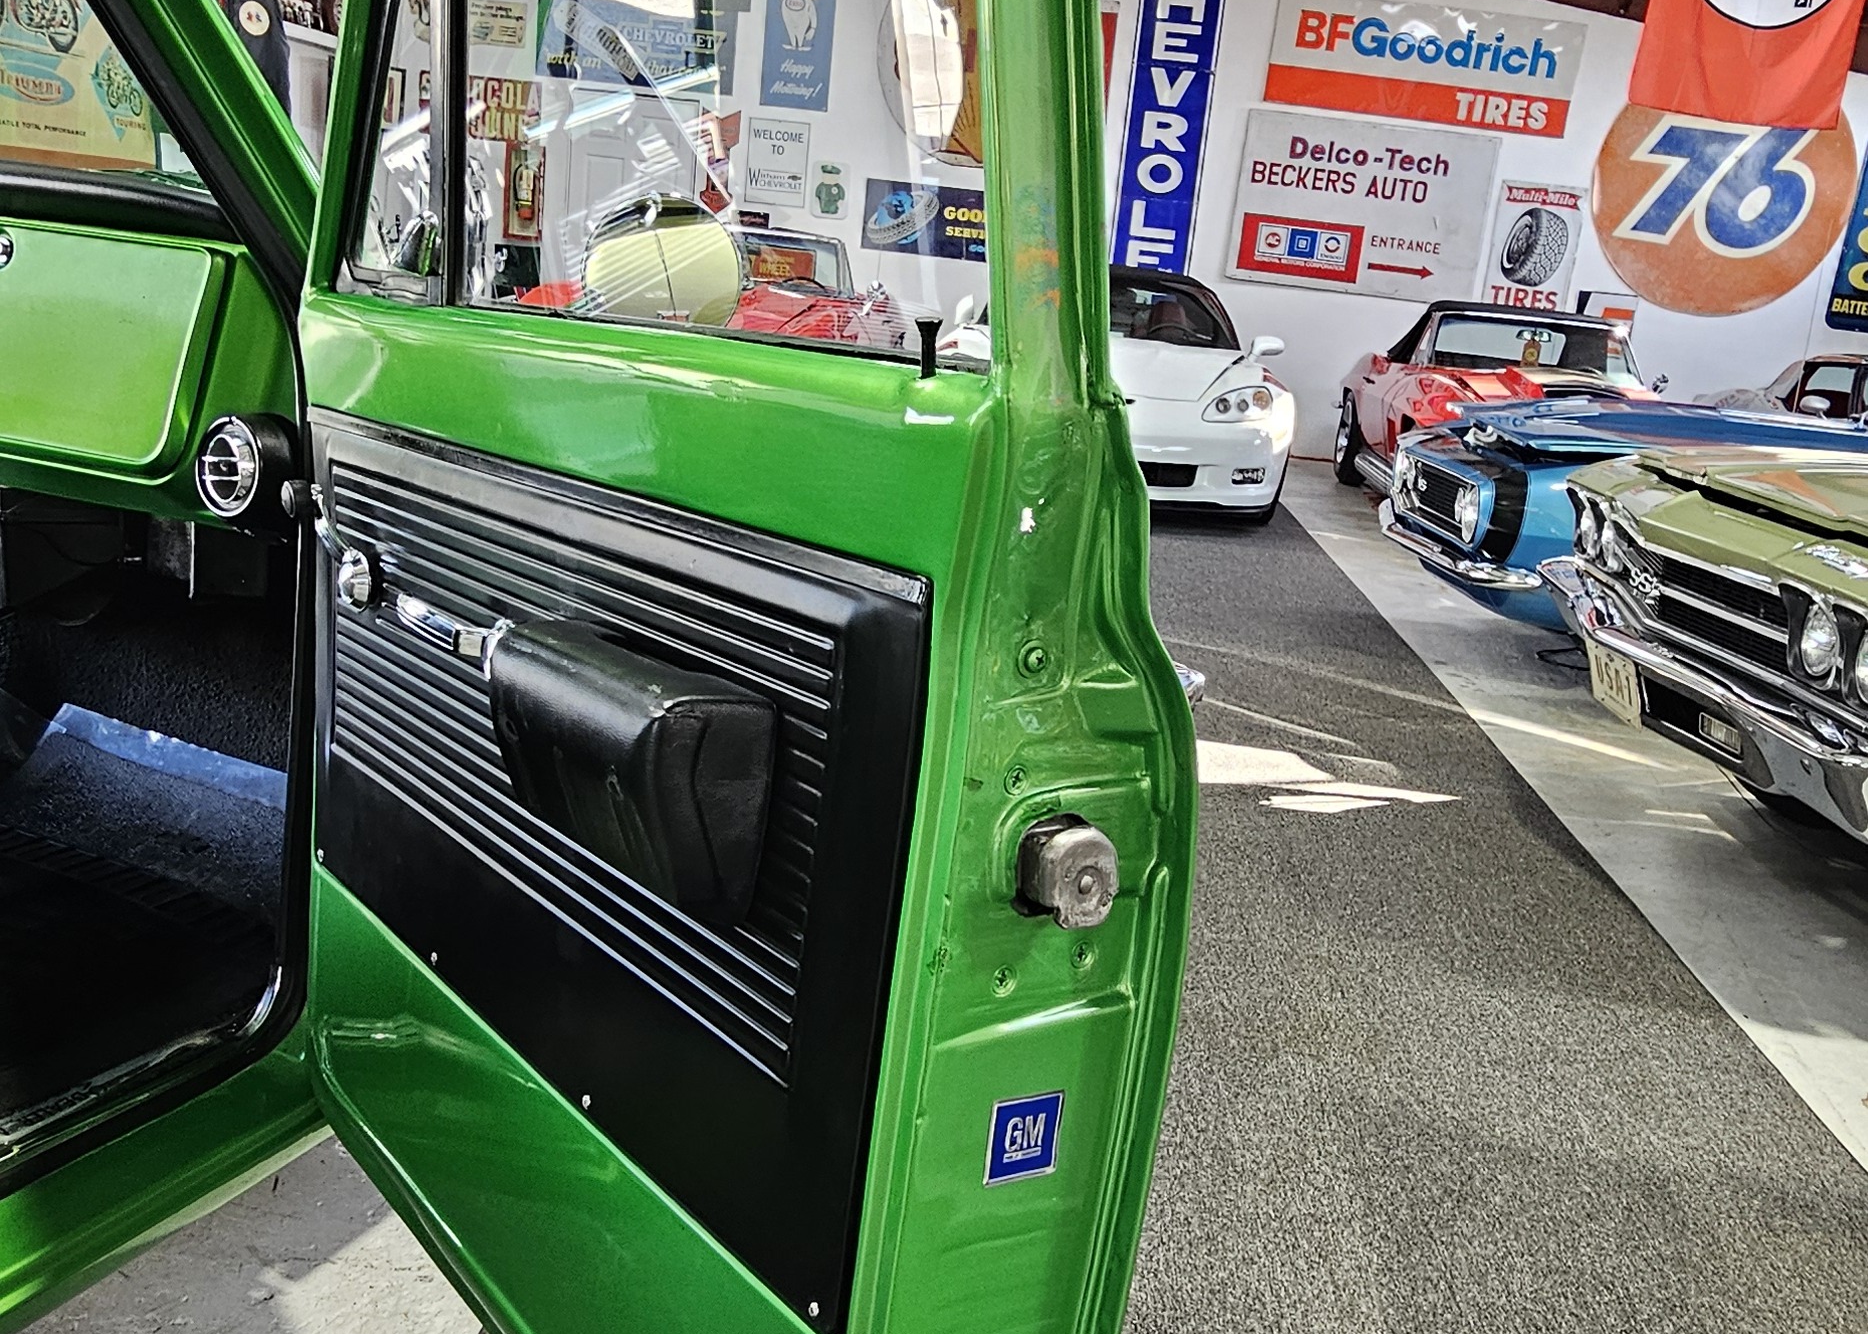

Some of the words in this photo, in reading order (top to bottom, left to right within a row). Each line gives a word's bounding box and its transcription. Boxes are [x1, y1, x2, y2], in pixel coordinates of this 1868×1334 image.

[622, 26, 714, 52] CHEVROLET
[1295, 9, 1558, 79] BFGoodrich
[780, 58, 814, 79] Happy
[1455, 91, 1549, 130] TIRES
[753, 128, 805, 144] WELCOME
[771, 144, 785, 156] TO
[1289, 135, 1450, 178] Delco-Tech
[758, 180, 802, 191] CHEVROLET
[1251, 160, 1357, 195] BECKERS
[1365, 175, 1428, 204] AUTO
[1612, 113, 1816, 259] 76
[943, 206, 986, 224] GOO
[945, 225, 986, 240] SERVI
[1370, 235, 1441, 255] ENTRANCE
[1491, 285, 1558, 311] TIRES
[1004, 1112, 1046, 1153] GM
